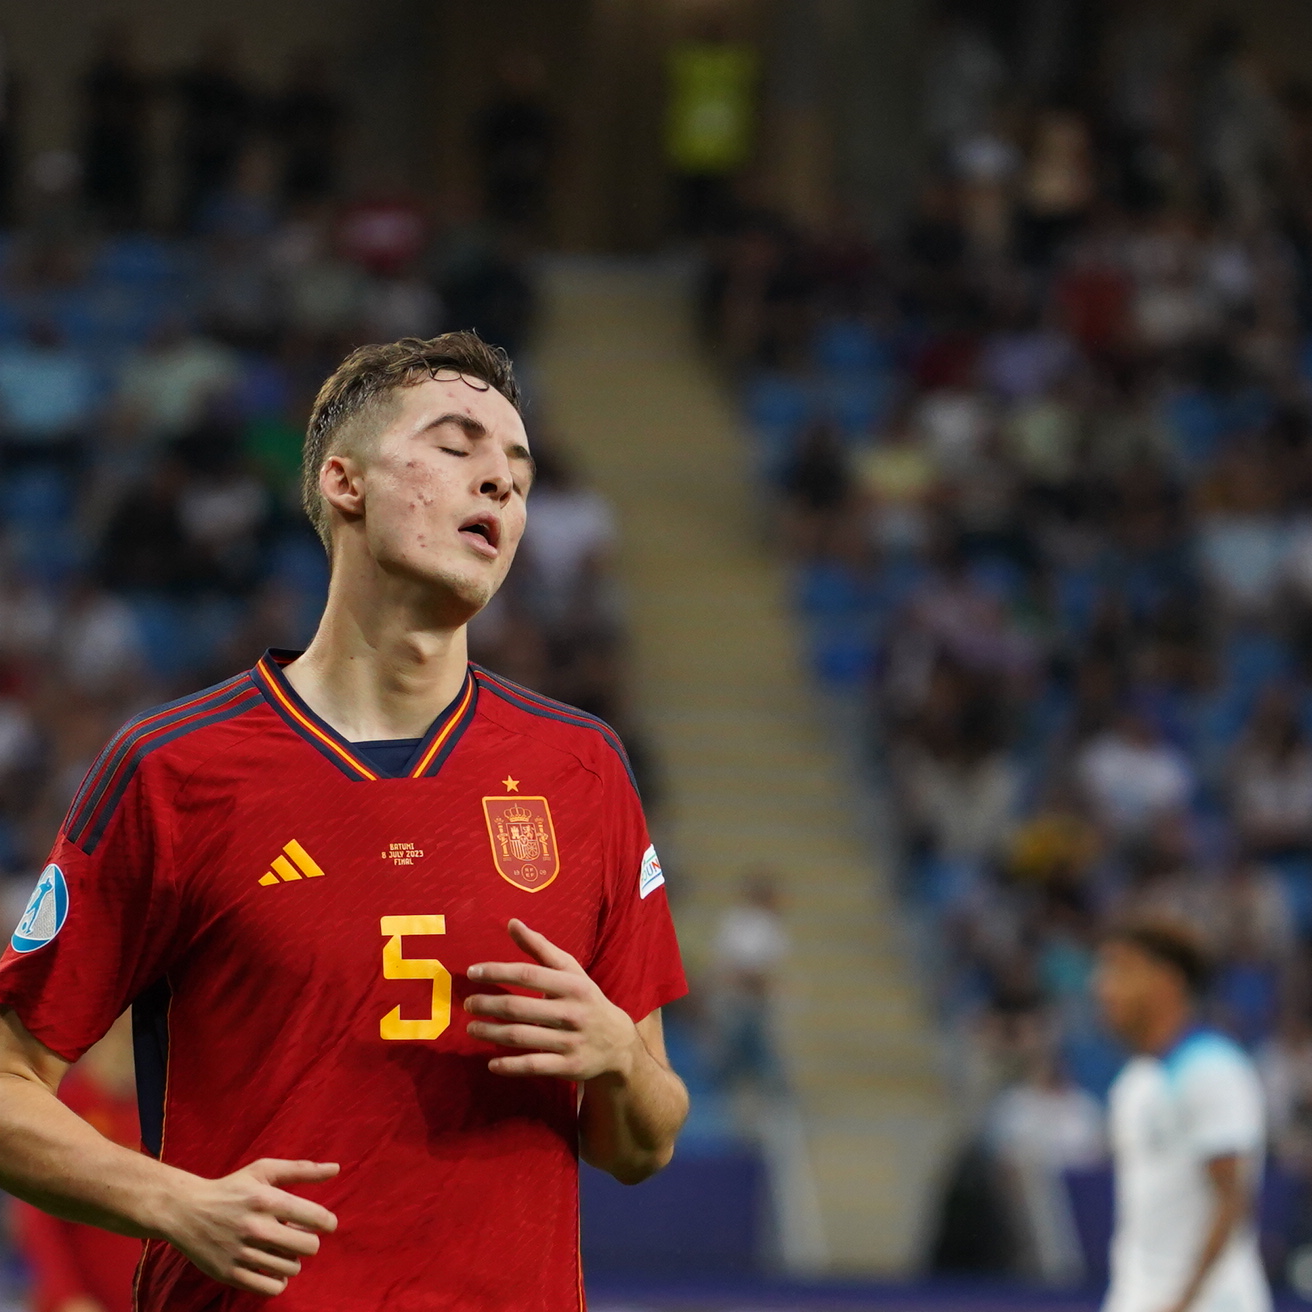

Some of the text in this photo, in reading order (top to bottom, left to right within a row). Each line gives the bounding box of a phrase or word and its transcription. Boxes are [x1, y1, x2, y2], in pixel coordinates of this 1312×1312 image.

[389, 843, 415, 851] BATUMI
[381, 850, 424, 859] 8 JULY 2023
[394, 858, 414, 866] FINAL
[379, 914, 452, 1040] 5
